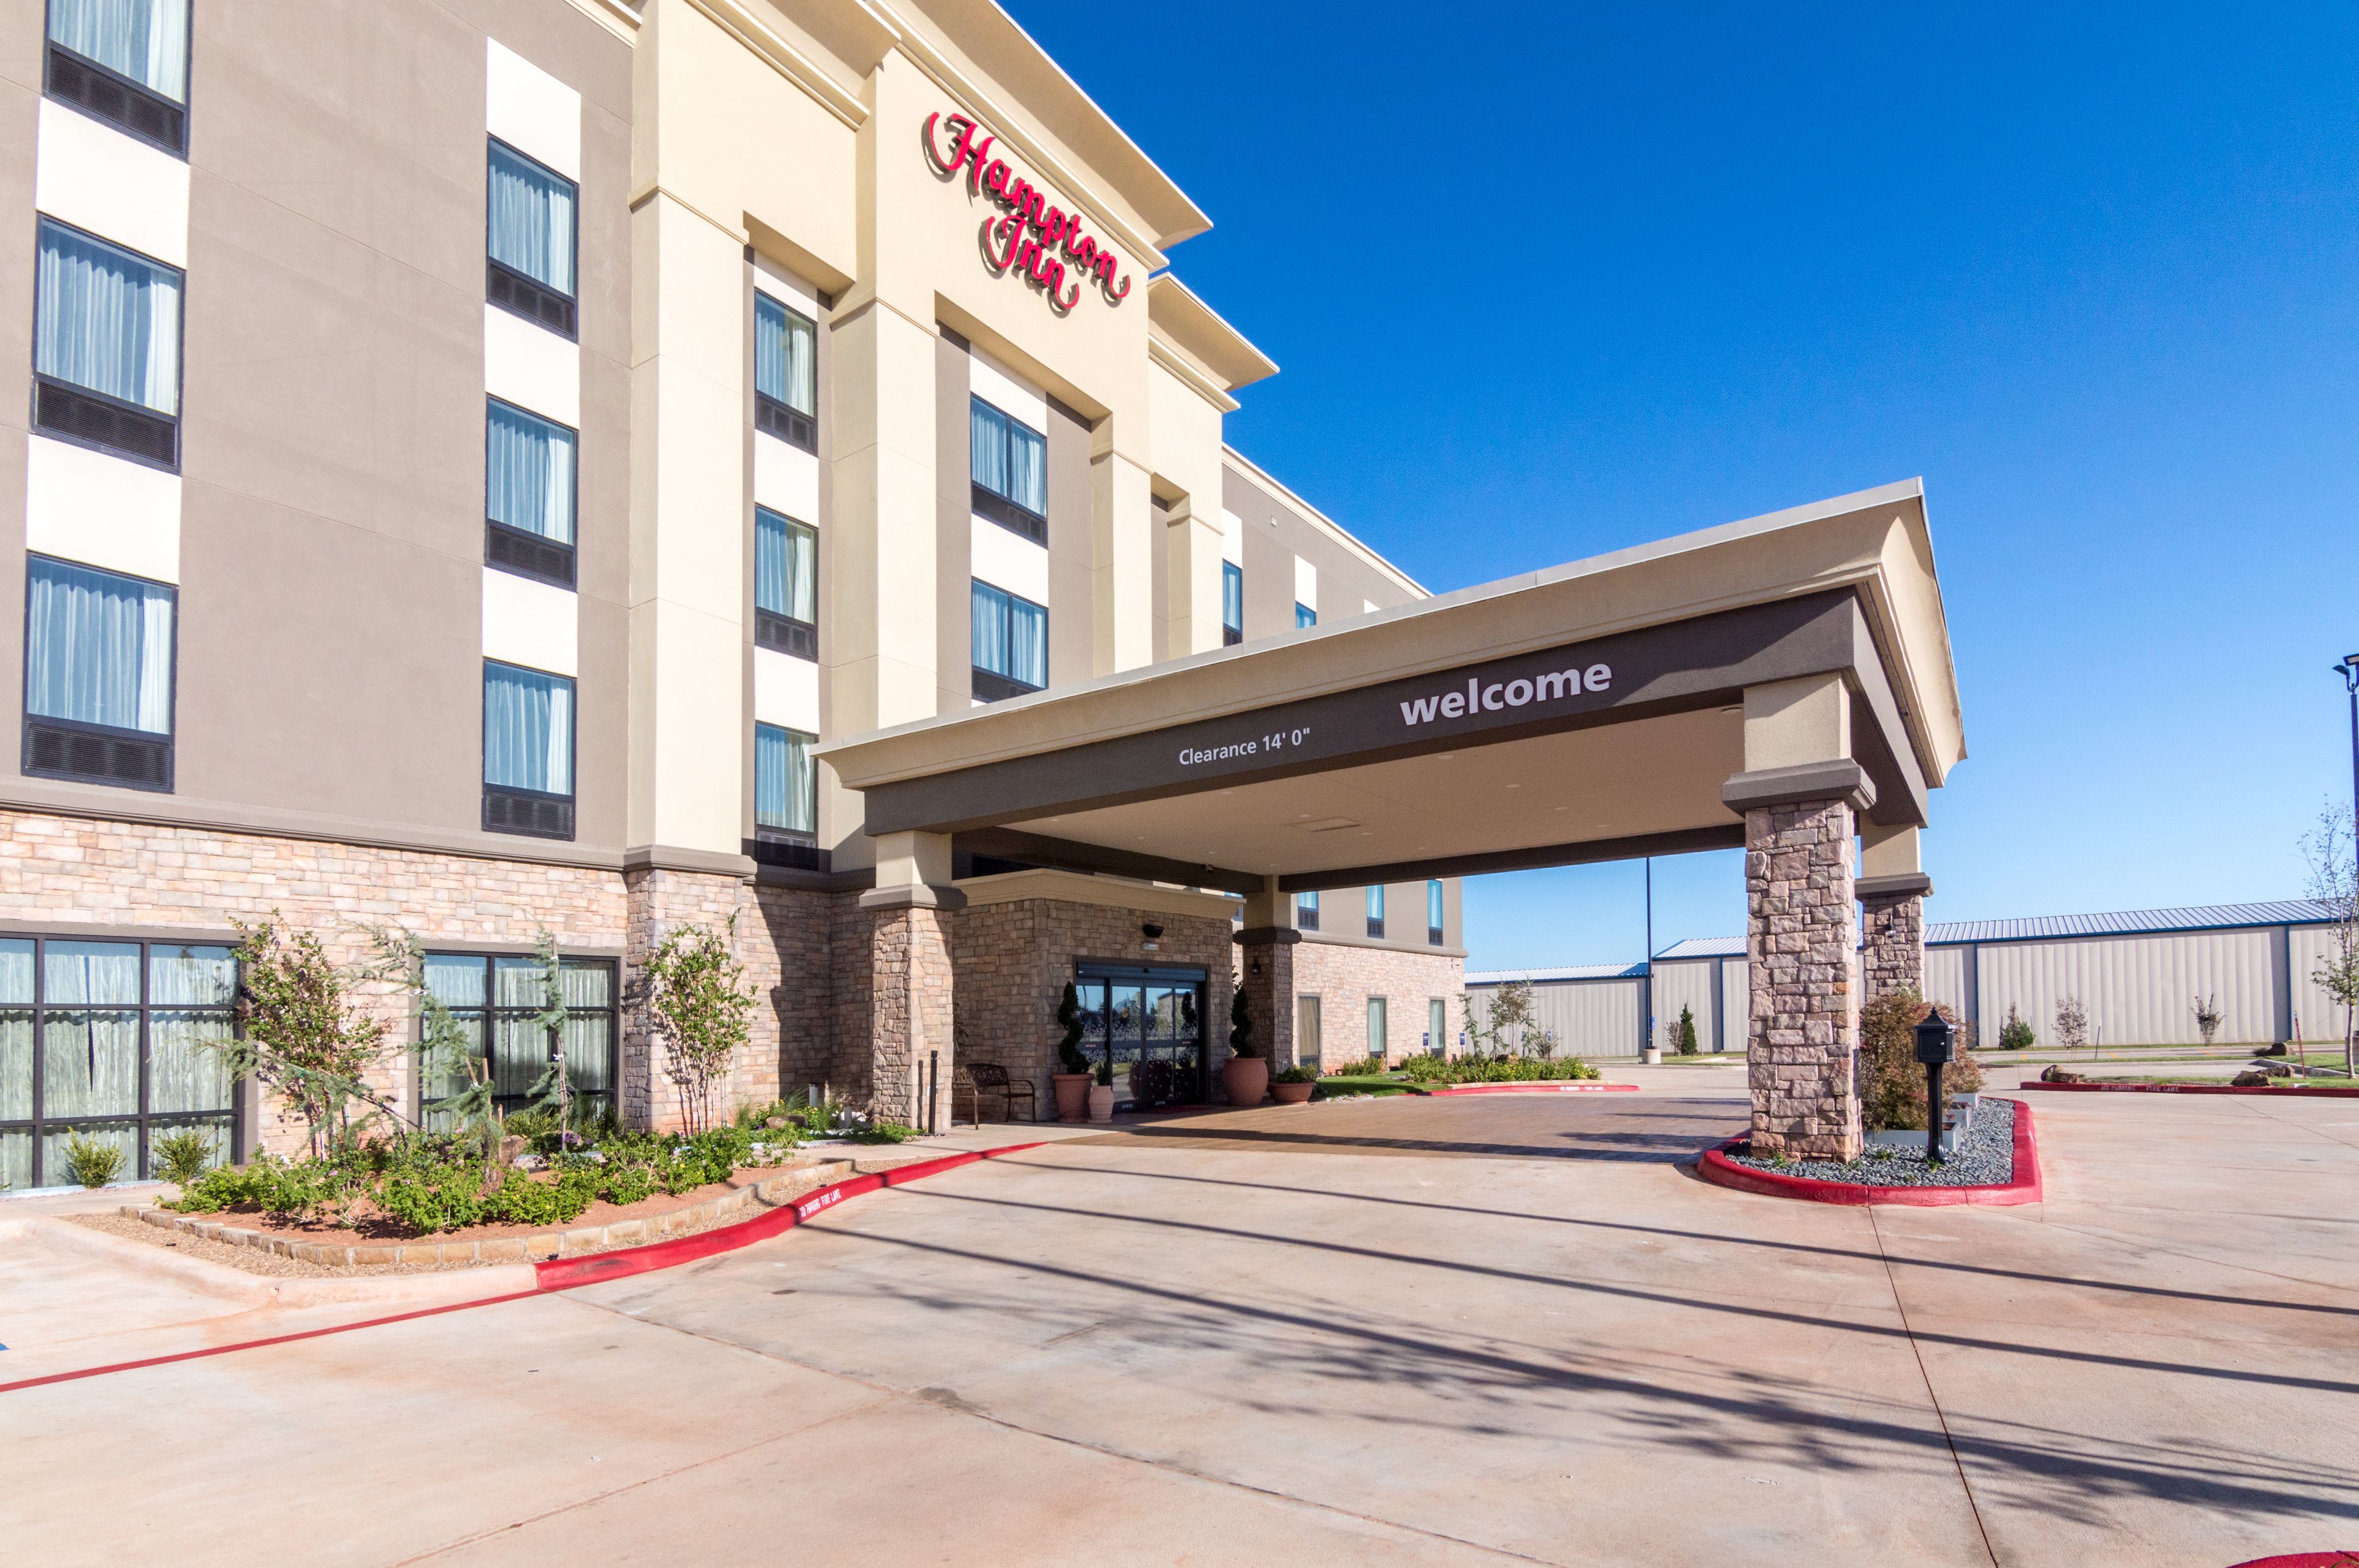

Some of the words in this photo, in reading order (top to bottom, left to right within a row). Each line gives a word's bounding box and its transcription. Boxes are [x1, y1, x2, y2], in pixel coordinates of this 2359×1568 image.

[926, 112, 1130, 298] Hampton
[983, 215, 1080, 308] Inn
[1400, 663, 1612, 725] welcome
[1179, 741, 1257, 765] Clearance
[1262, 733, 1286, 751] 14'
[1291, 728, 1310, 746] 0"
